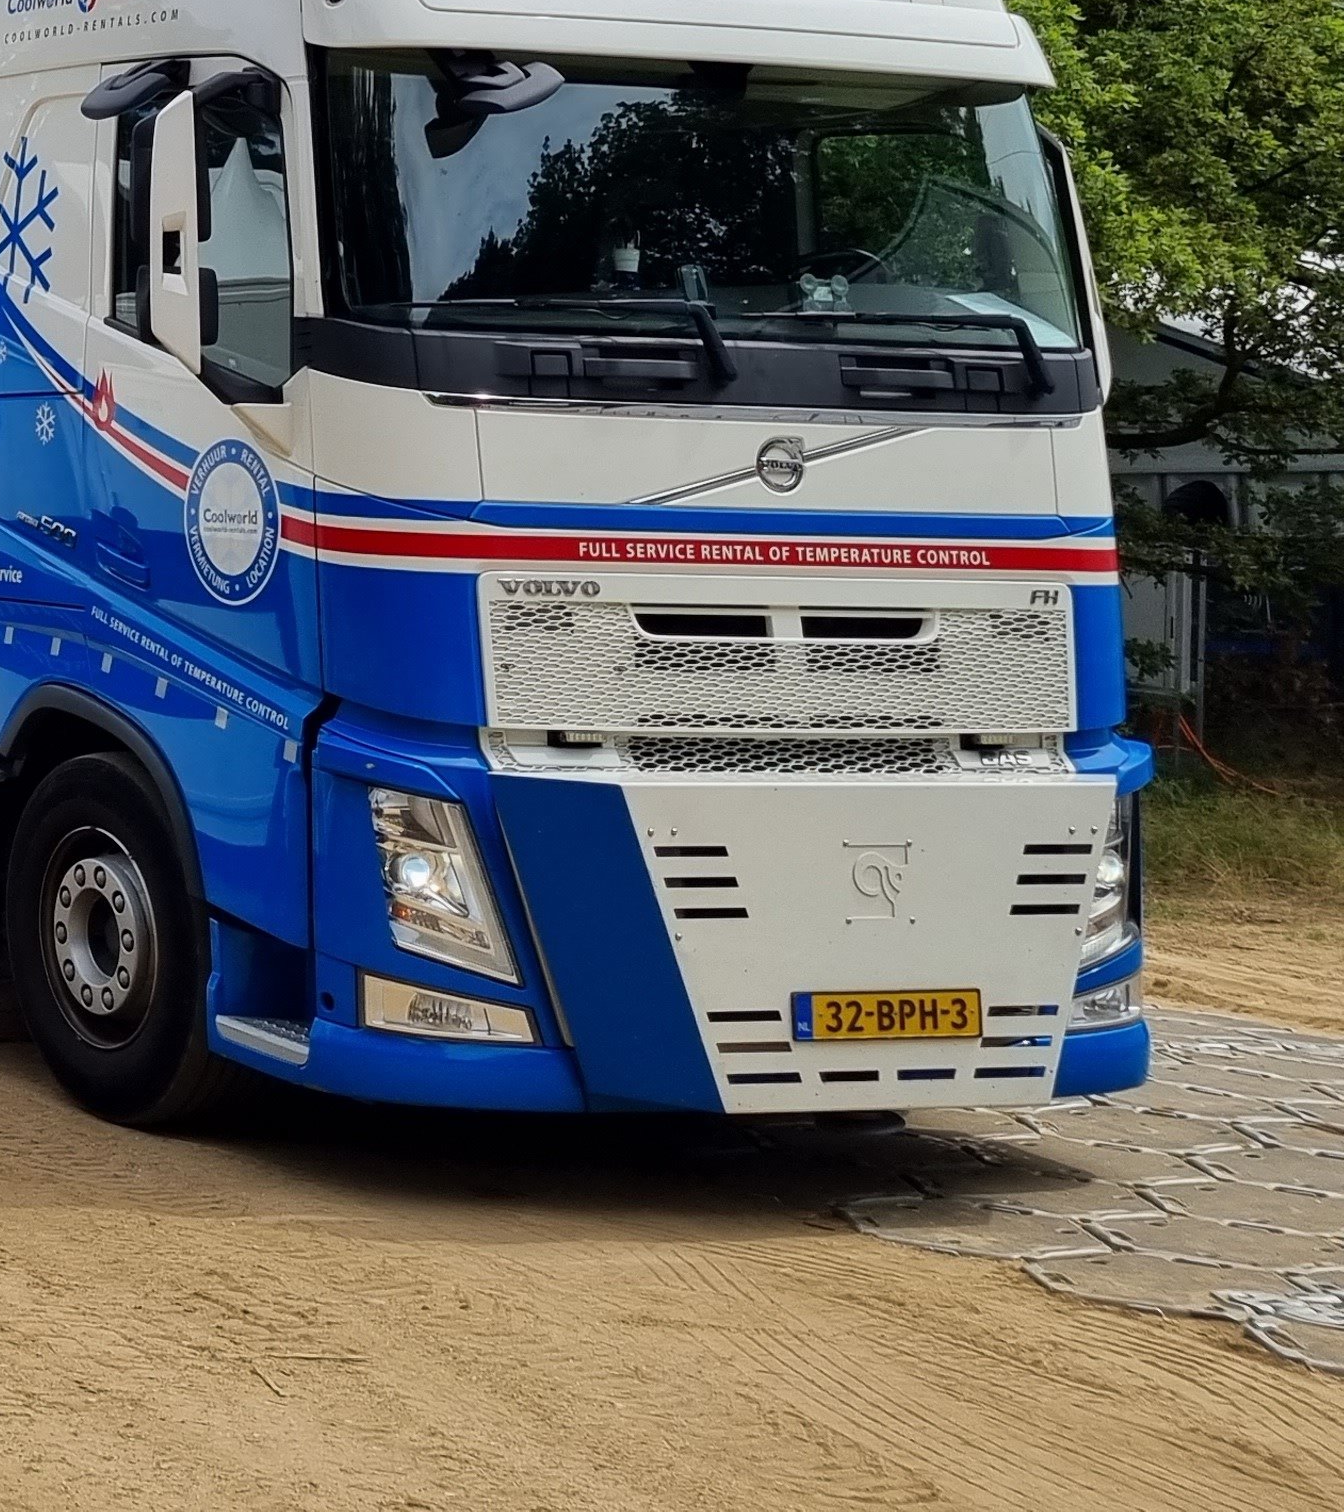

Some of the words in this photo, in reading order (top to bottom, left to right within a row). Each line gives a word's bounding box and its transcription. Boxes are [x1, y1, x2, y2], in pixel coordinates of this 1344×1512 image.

[4, 9, 180, 44] COOLWORLD-RENTALS.COM
[190, 445, 228, 496] VERHUUR
[240, 448, 271, 498] RENTAL
[759, 459, 803, 472] VOLVO
[40, 515, 78, 549] 500
[203, 508, 259, 526] Coolworld
[189, 524, 231, 595] VERMIETUNG
[245, 526, 275, 589] LOCATION
[579, 542, 621, 558] FULL
[625, 542, 696, 560] SERVICE
[700, 544, 764, 561] RENTAL
[768, 545, 790, 561] OF
[795, 546, 912, 564] TEMPERATURE
[916, 549, 991, 566] CONTROL
[496, 578, 601, 598] VOLVO
[1030, 589, 1059, 606] FH
[90, 605, 108, 625] FULL
[109, 616, 140, 644] SERVICE
[140, 635, 169, 662] RENTAL
[170, 653, 182, 669] OF
[184, 658, 245, 706] TEMPERATURE
[245, 696, 289, 731] CONTROL
[797, 1021, 811, 1032] NL
[825, 997, 968, 1033] 32-BPH-3
